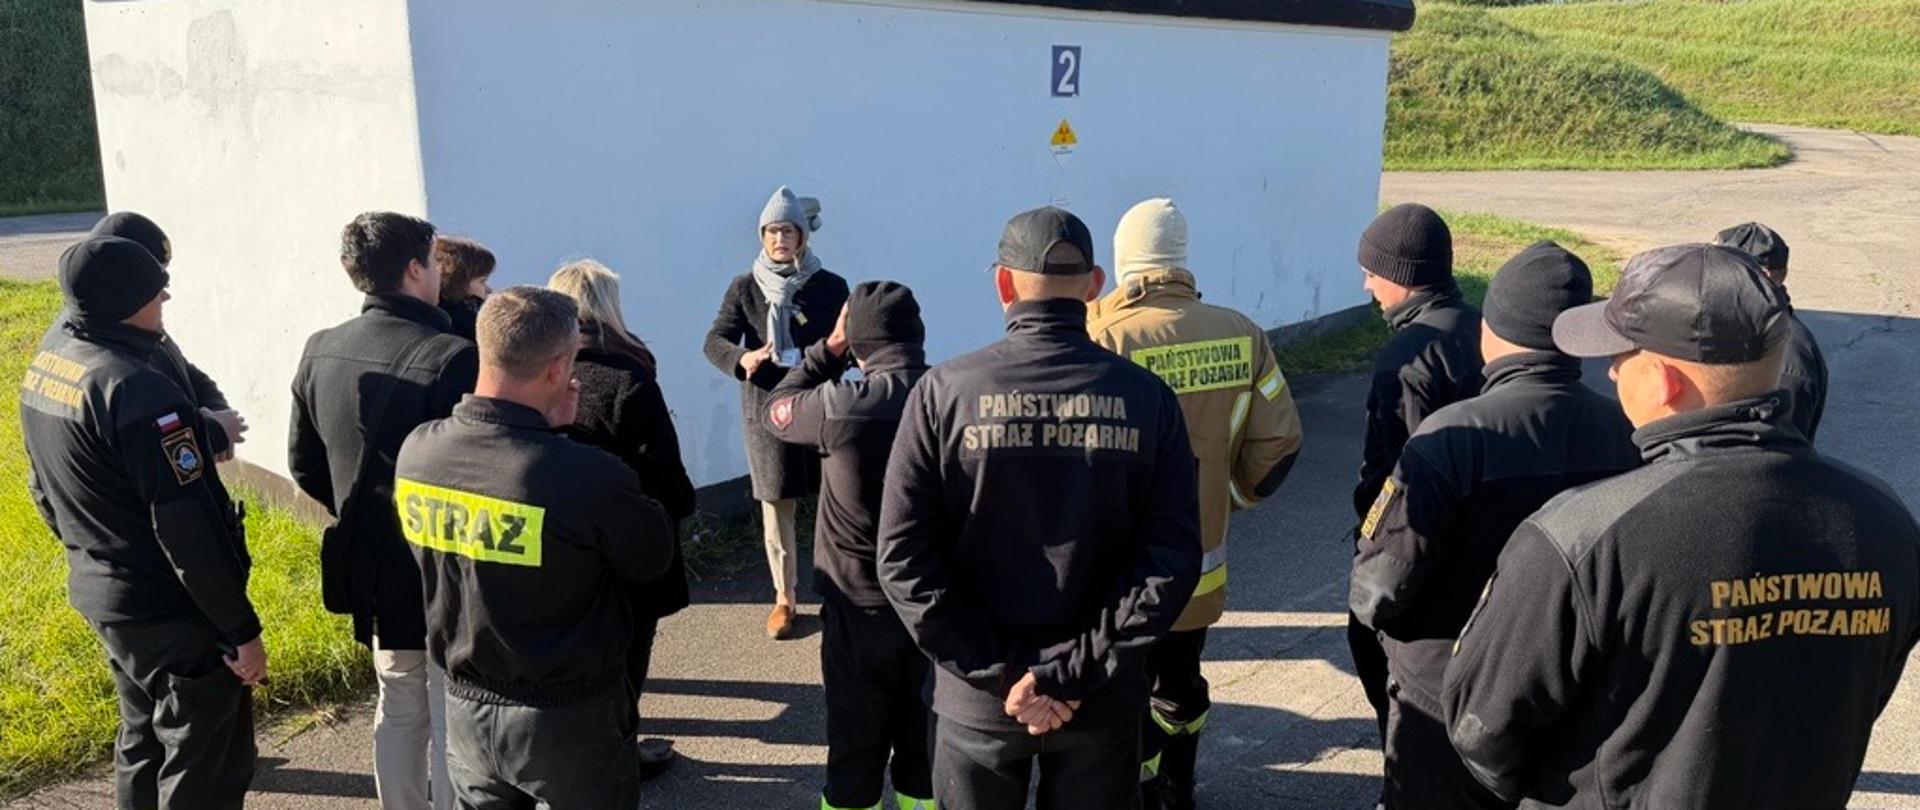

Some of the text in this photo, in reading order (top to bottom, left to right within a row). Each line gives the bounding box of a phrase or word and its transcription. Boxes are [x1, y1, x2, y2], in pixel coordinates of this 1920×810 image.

[1057, 49, 1075, 93] 2
[1145, 344, 1241, 372] PAŃSTWOWA
[979, 390, 1126, 419] PAŃSTWOWA
[964, 424, 1139, 452] STRAŻ POŻARNA
[1711, 572, 1882, 608] PAŃSTWOWA
